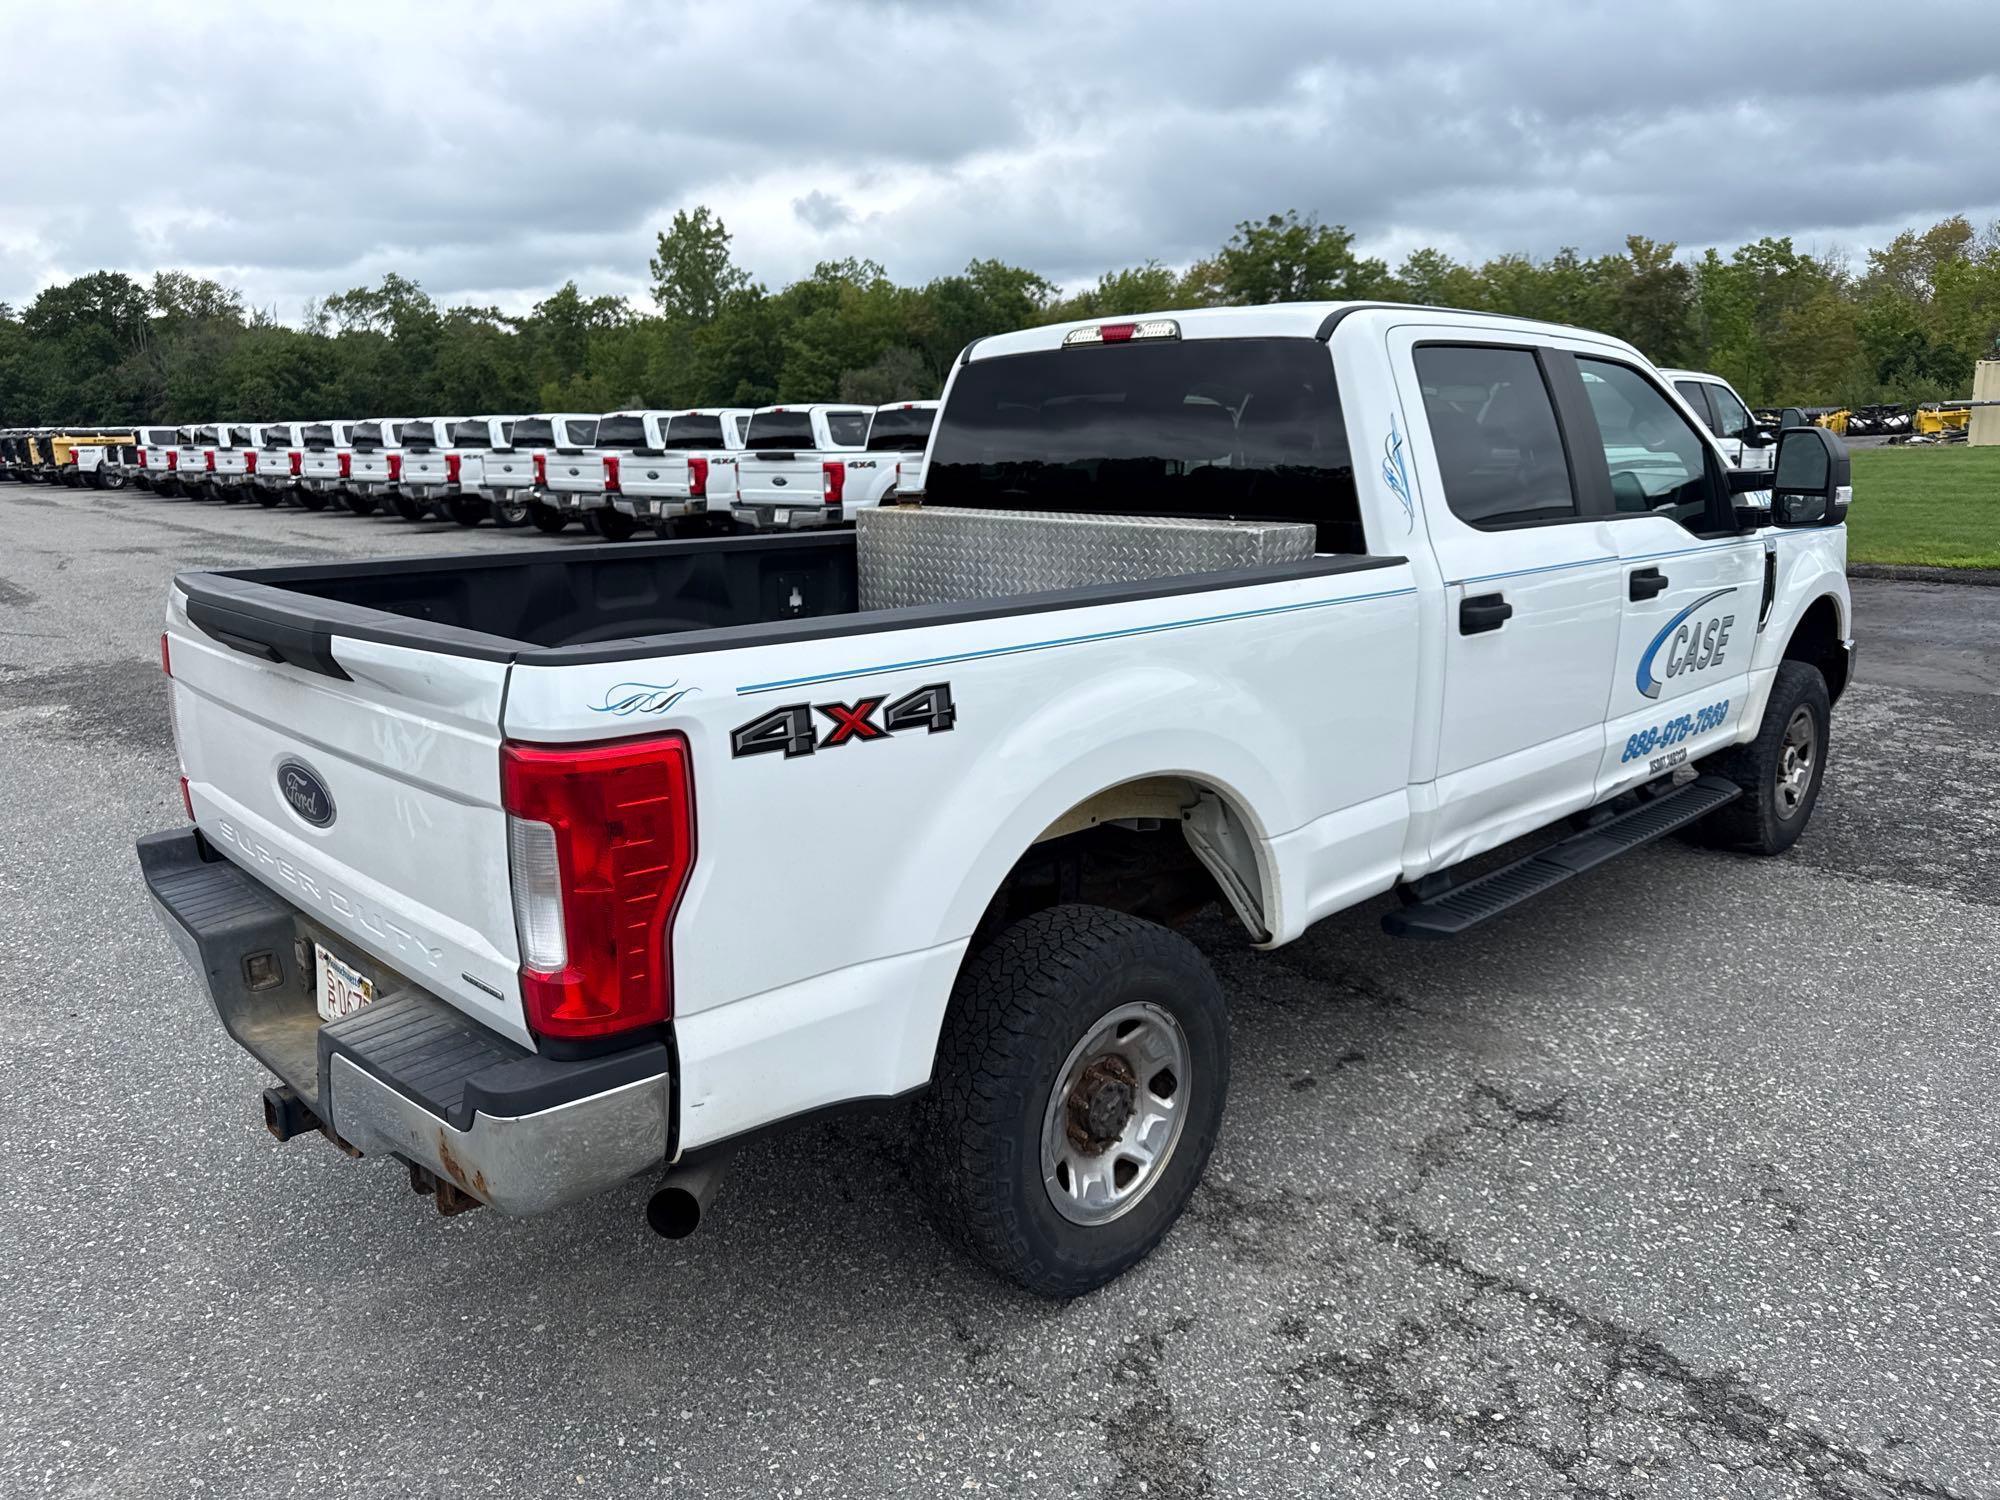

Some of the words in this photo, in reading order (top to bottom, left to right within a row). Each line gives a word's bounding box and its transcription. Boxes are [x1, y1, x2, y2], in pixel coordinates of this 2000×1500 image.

[1666, 615, 1735, 678] CASE
[1621, 699, 1729, 763] 888-978-7669
[285, 771, 318, 815] Ford
[219, 819, 322, 900] SUPER
[327, 887, 443, 968] DUTY
